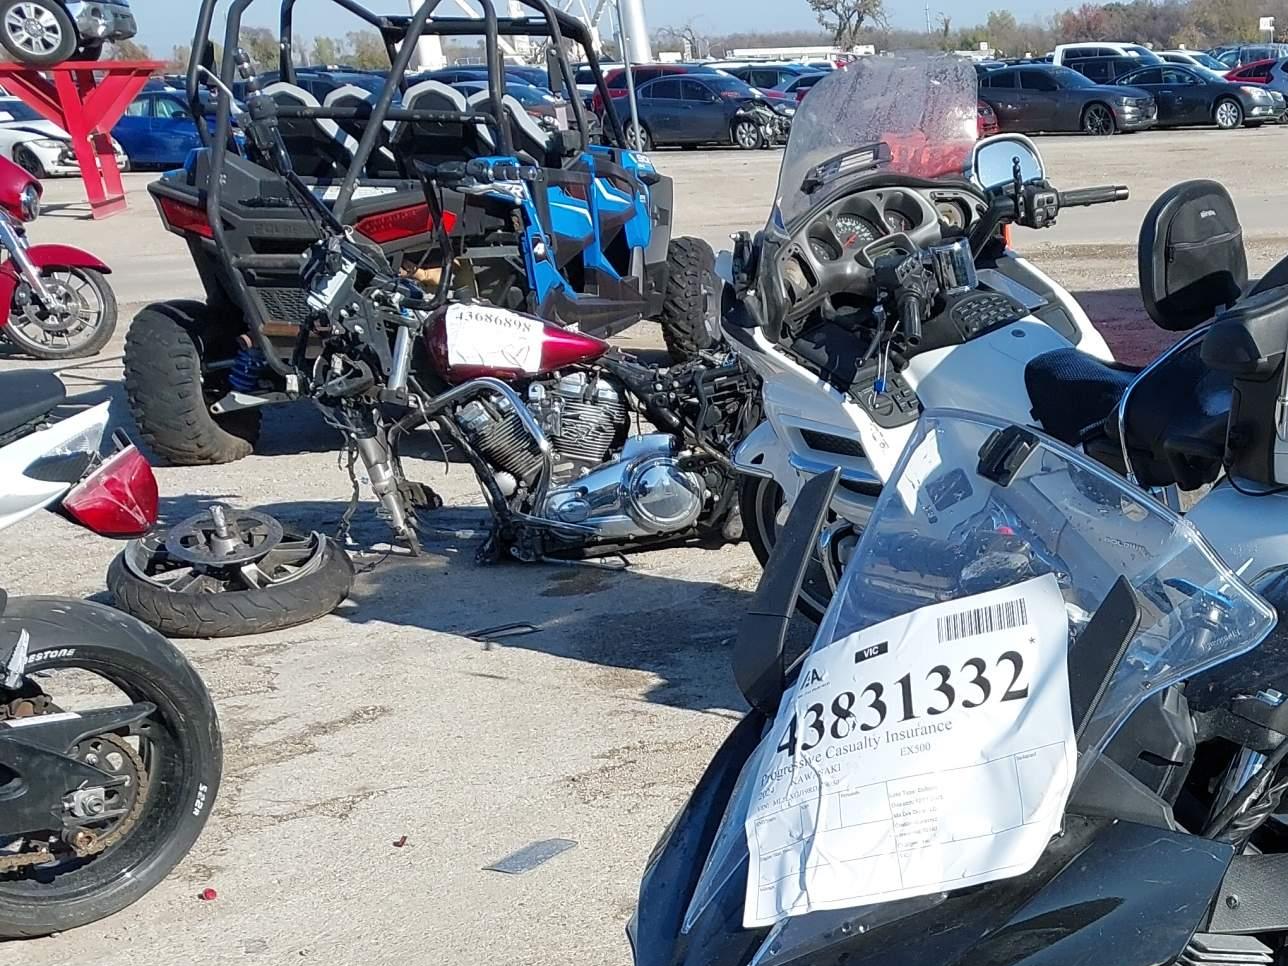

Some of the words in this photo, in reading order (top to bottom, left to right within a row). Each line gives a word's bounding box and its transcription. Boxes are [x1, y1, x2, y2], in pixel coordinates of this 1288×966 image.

[456, 311, 532, 333] 43686898
[27, 648, 76, 663] ESTONE
[864, 645, 879, 658] VIC
[776, 650, 1030, 758] 43831332
[825, 733, 881, 759] Casualty
[885, 720, 953, 744] Insurance
[900, 742, 931, 757] EX500
